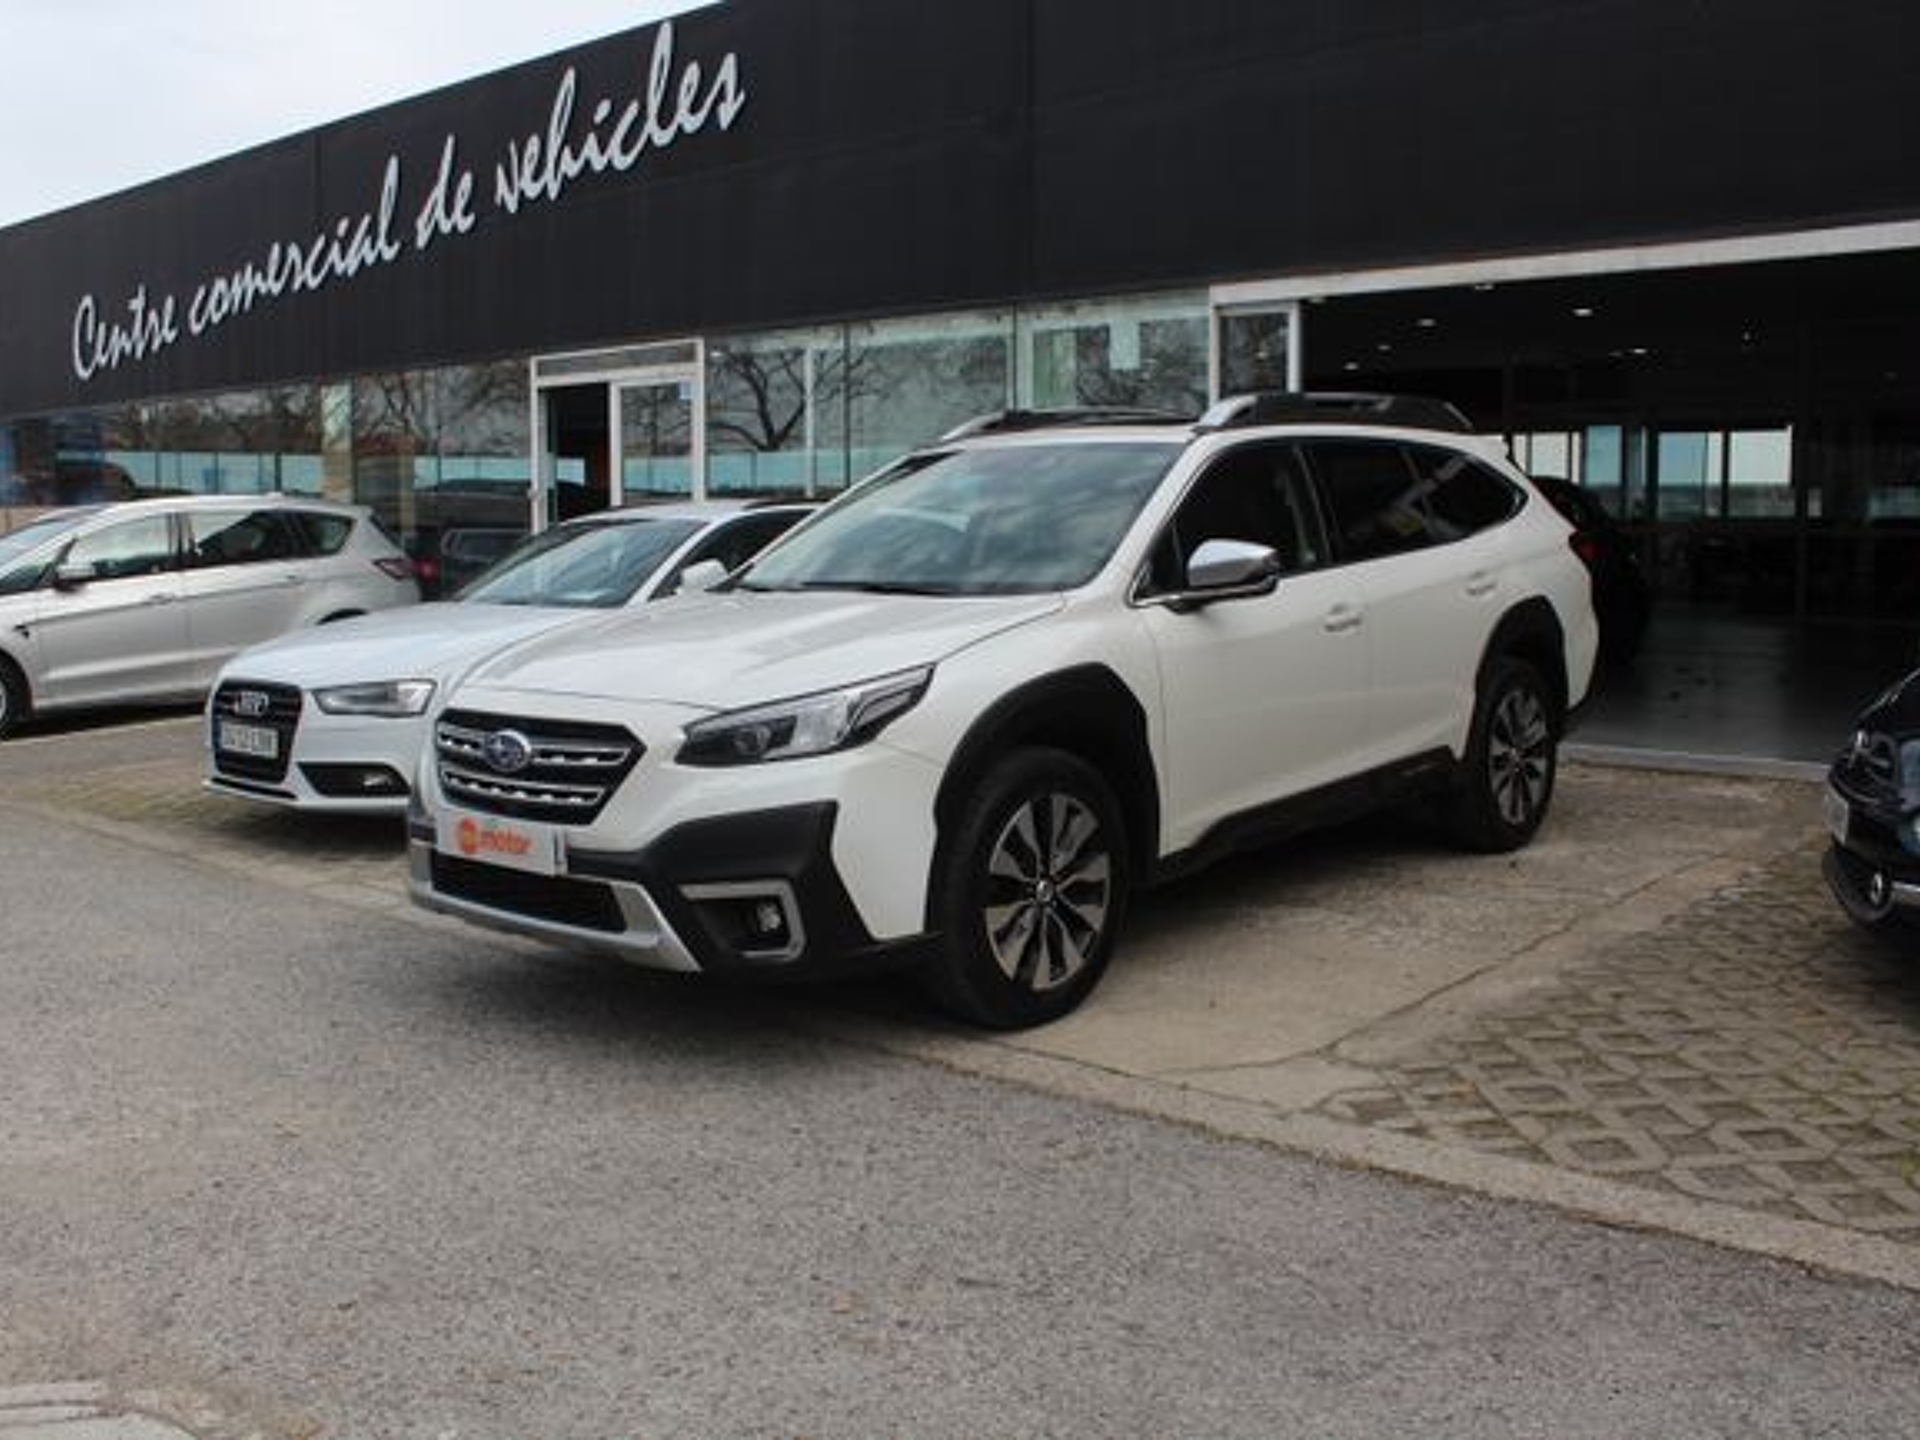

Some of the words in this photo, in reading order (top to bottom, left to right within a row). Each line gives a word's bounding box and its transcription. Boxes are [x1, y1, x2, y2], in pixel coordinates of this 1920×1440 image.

[73, 283, 178, 380] Centre
[189, 155, 400, 335] comercial
[415, 134, 475, 249] de
[494, 20, 746, 214] vehicles
